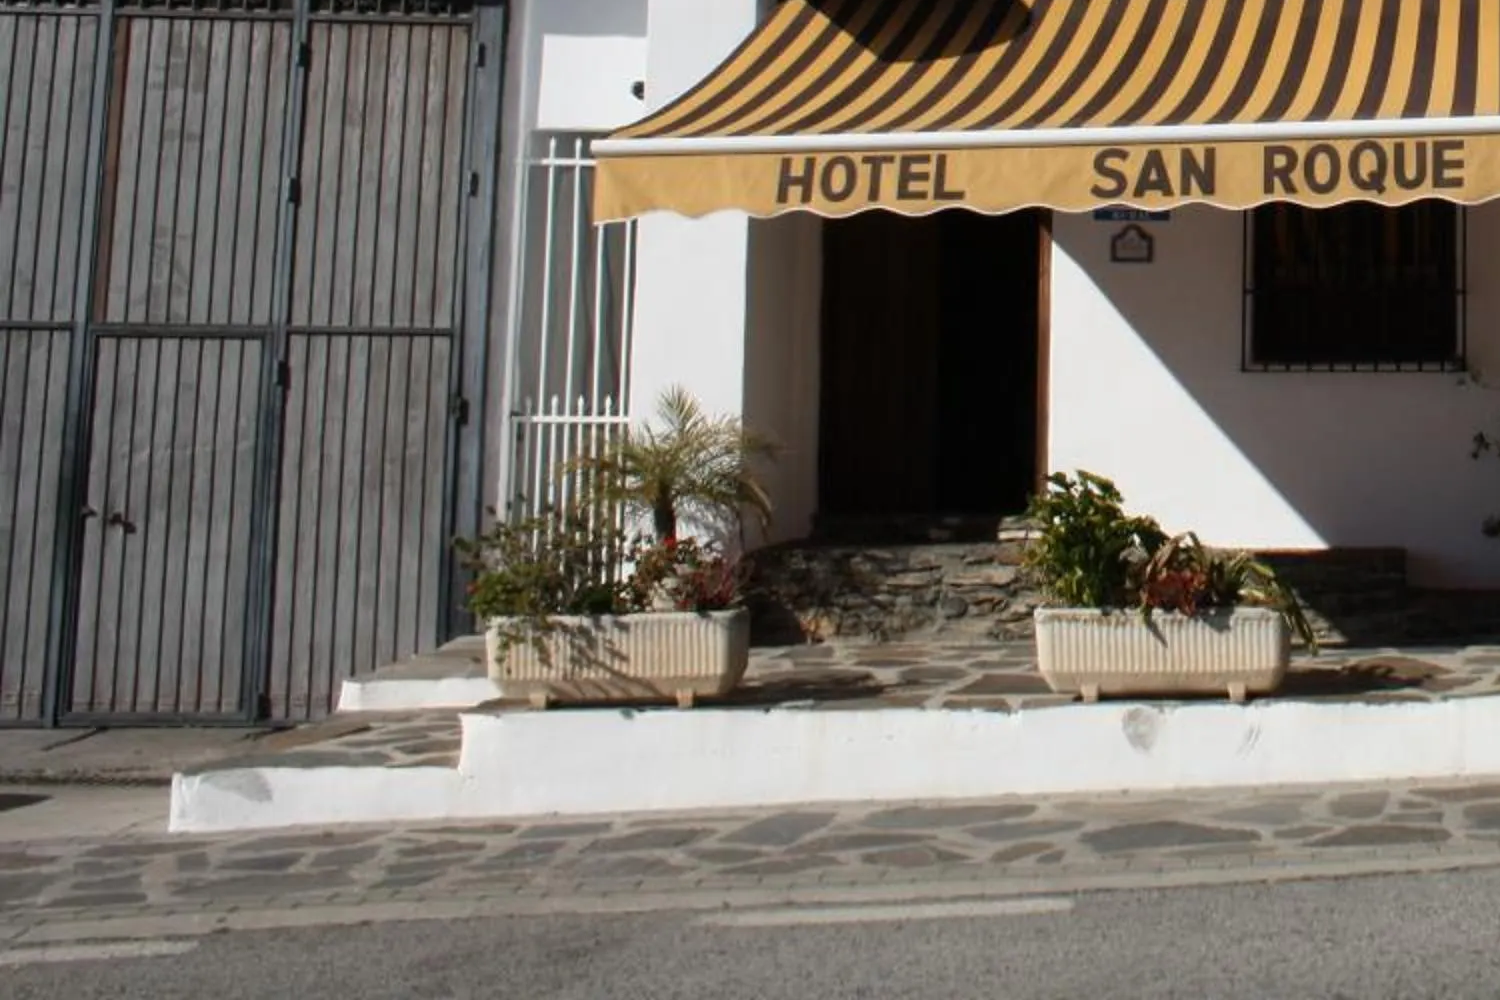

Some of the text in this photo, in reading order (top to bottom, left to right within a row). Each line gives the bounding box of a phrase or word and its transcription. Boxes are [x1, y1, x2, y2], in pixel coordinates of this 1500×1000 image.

[776, 139, 1465, 204] HOTEL SAN ROQUE
